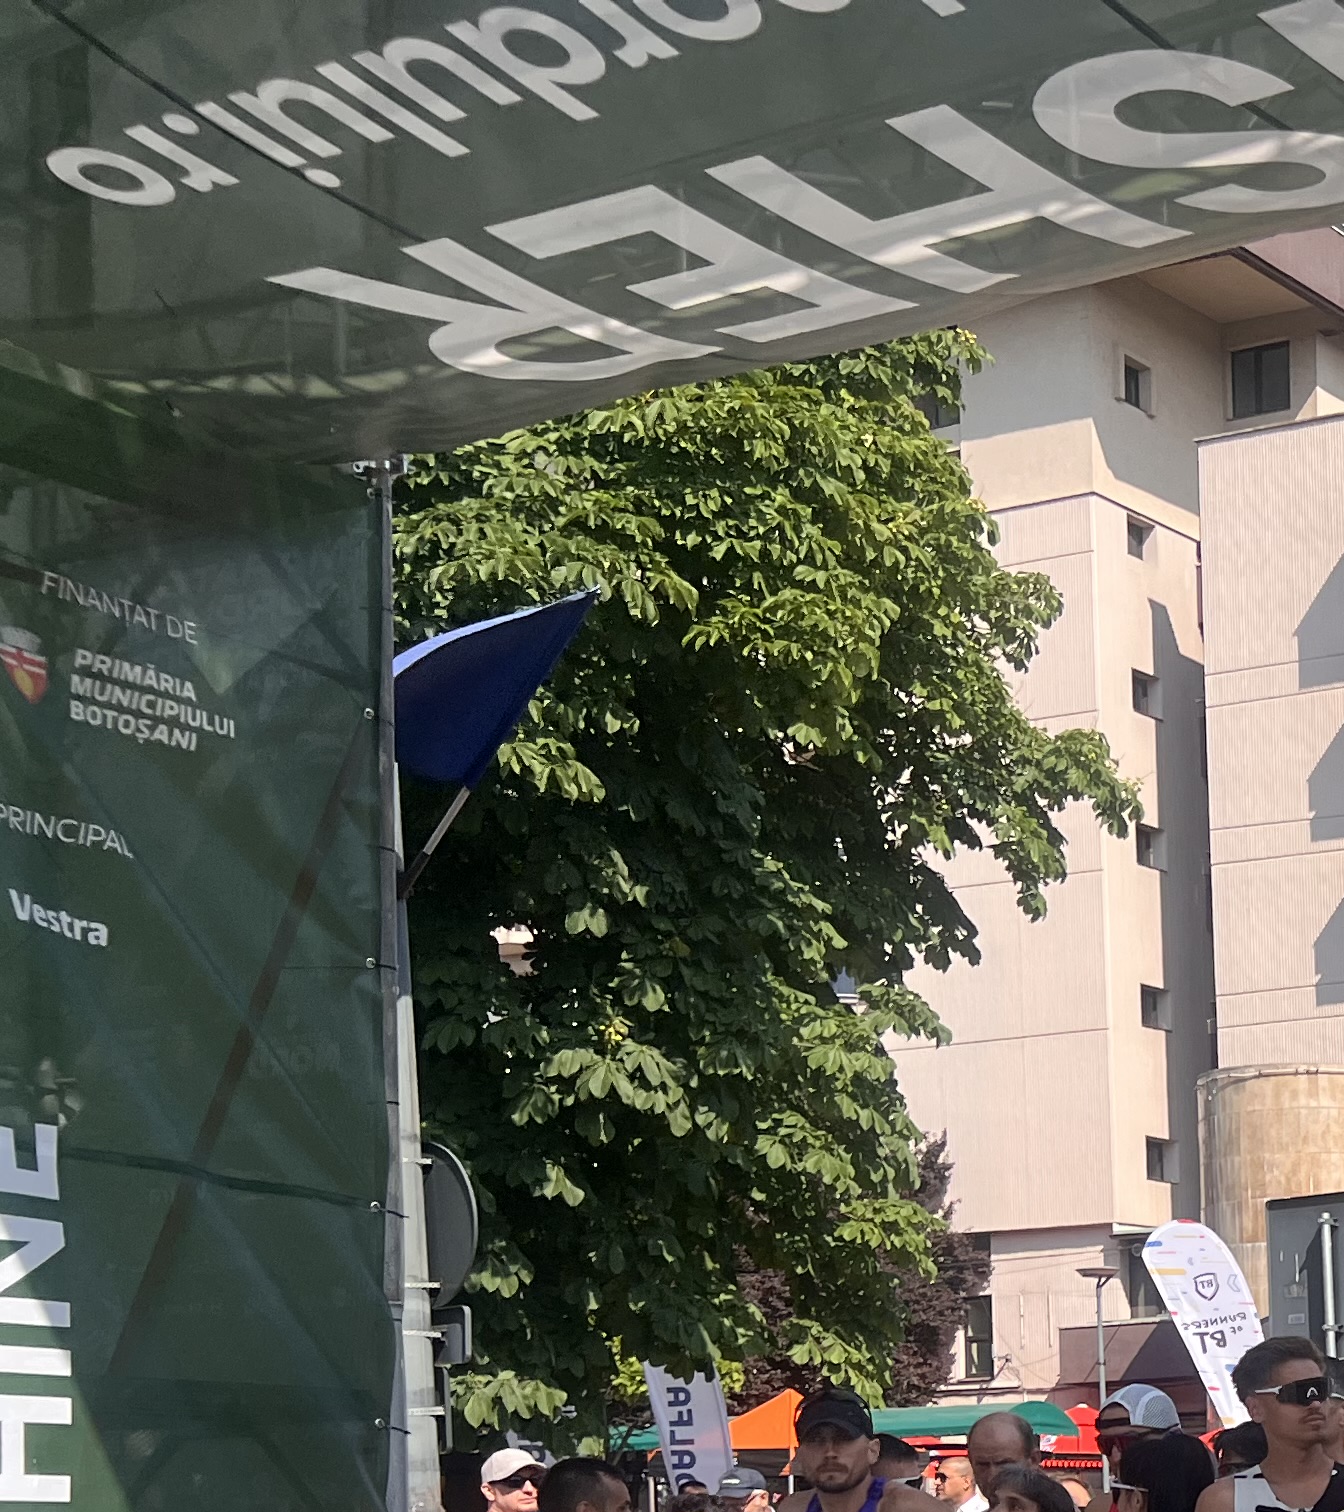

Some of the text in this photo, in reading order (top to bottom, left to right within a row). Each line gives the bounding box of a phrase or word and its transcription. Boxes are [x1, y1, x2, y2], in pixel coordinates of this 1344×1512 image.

[45, 0, 964, 207] ordului.ro
[166, 615, 200, 645] DE
[73, 647, 198, 702] PRIMĂRIA
[69, 673, 236, 740] MUNICIPIULUI
[69, 698, 199, 752] BOTOȘANI
[7, 886, 110, 948] Vestra
